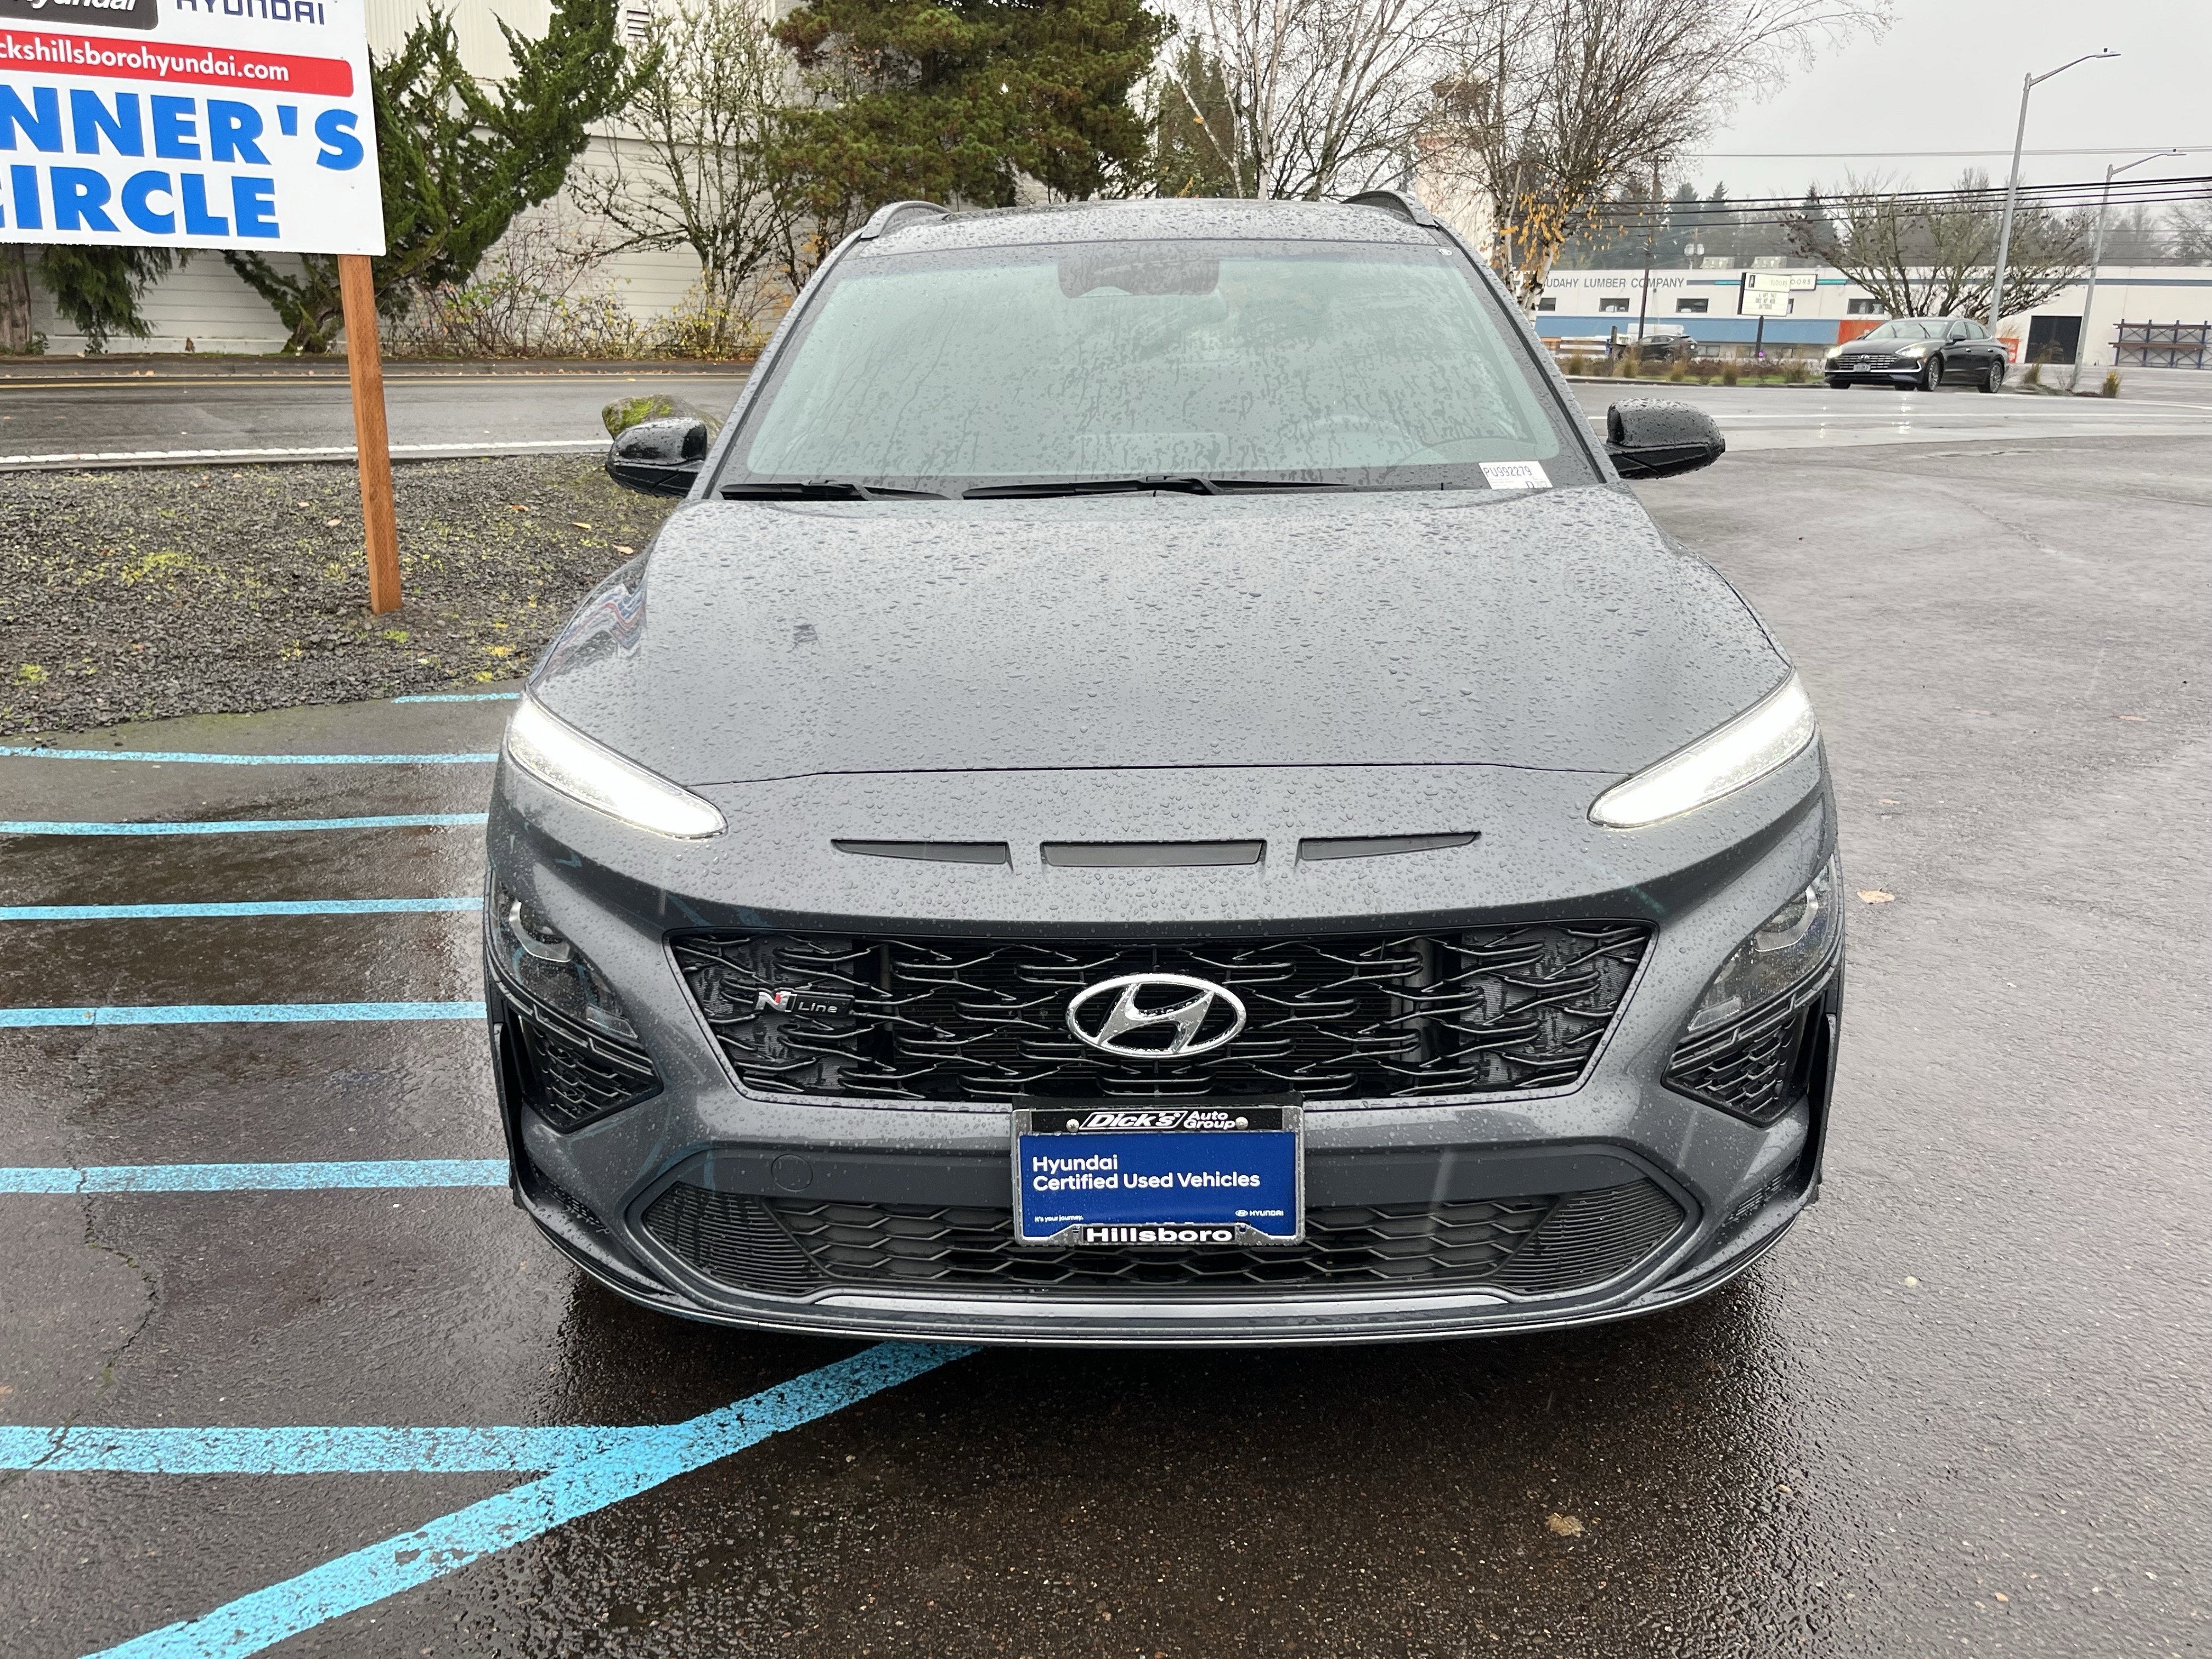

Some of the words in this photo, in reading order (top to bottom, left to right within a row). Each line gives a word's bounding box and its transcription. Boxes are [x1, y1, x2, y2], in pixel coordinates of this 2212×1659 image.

[0, 84, 364, 171] NNER'S
[0, 165, 280, 239] IRCLE
[1546, 278, 1579, 288] UDAHY
[1584, 278, 1626, 288] LUMBER
[1631, 277, 1685, 288] COMPANY
[1482, 466, 1532, 477] PU992279
[755, 991, 793, 1012] N
[798, 1002, 838, 1013] Line
[1087, 1113, 1180, 1127] Dick's
[1187, 1111, 1228, 1120] Auto
[1183, 1119, 1235, 1130] Group
[1032, 1154, 1118, 1174] Hyundai
[1032, 1172, 1118, 1191] Certified
[1124, 1172, 1173, 1188] Used
[1177, 1171, 1260, 1187] Vehicles
[1087, 1227, 1233, 1242] Hillsboro
